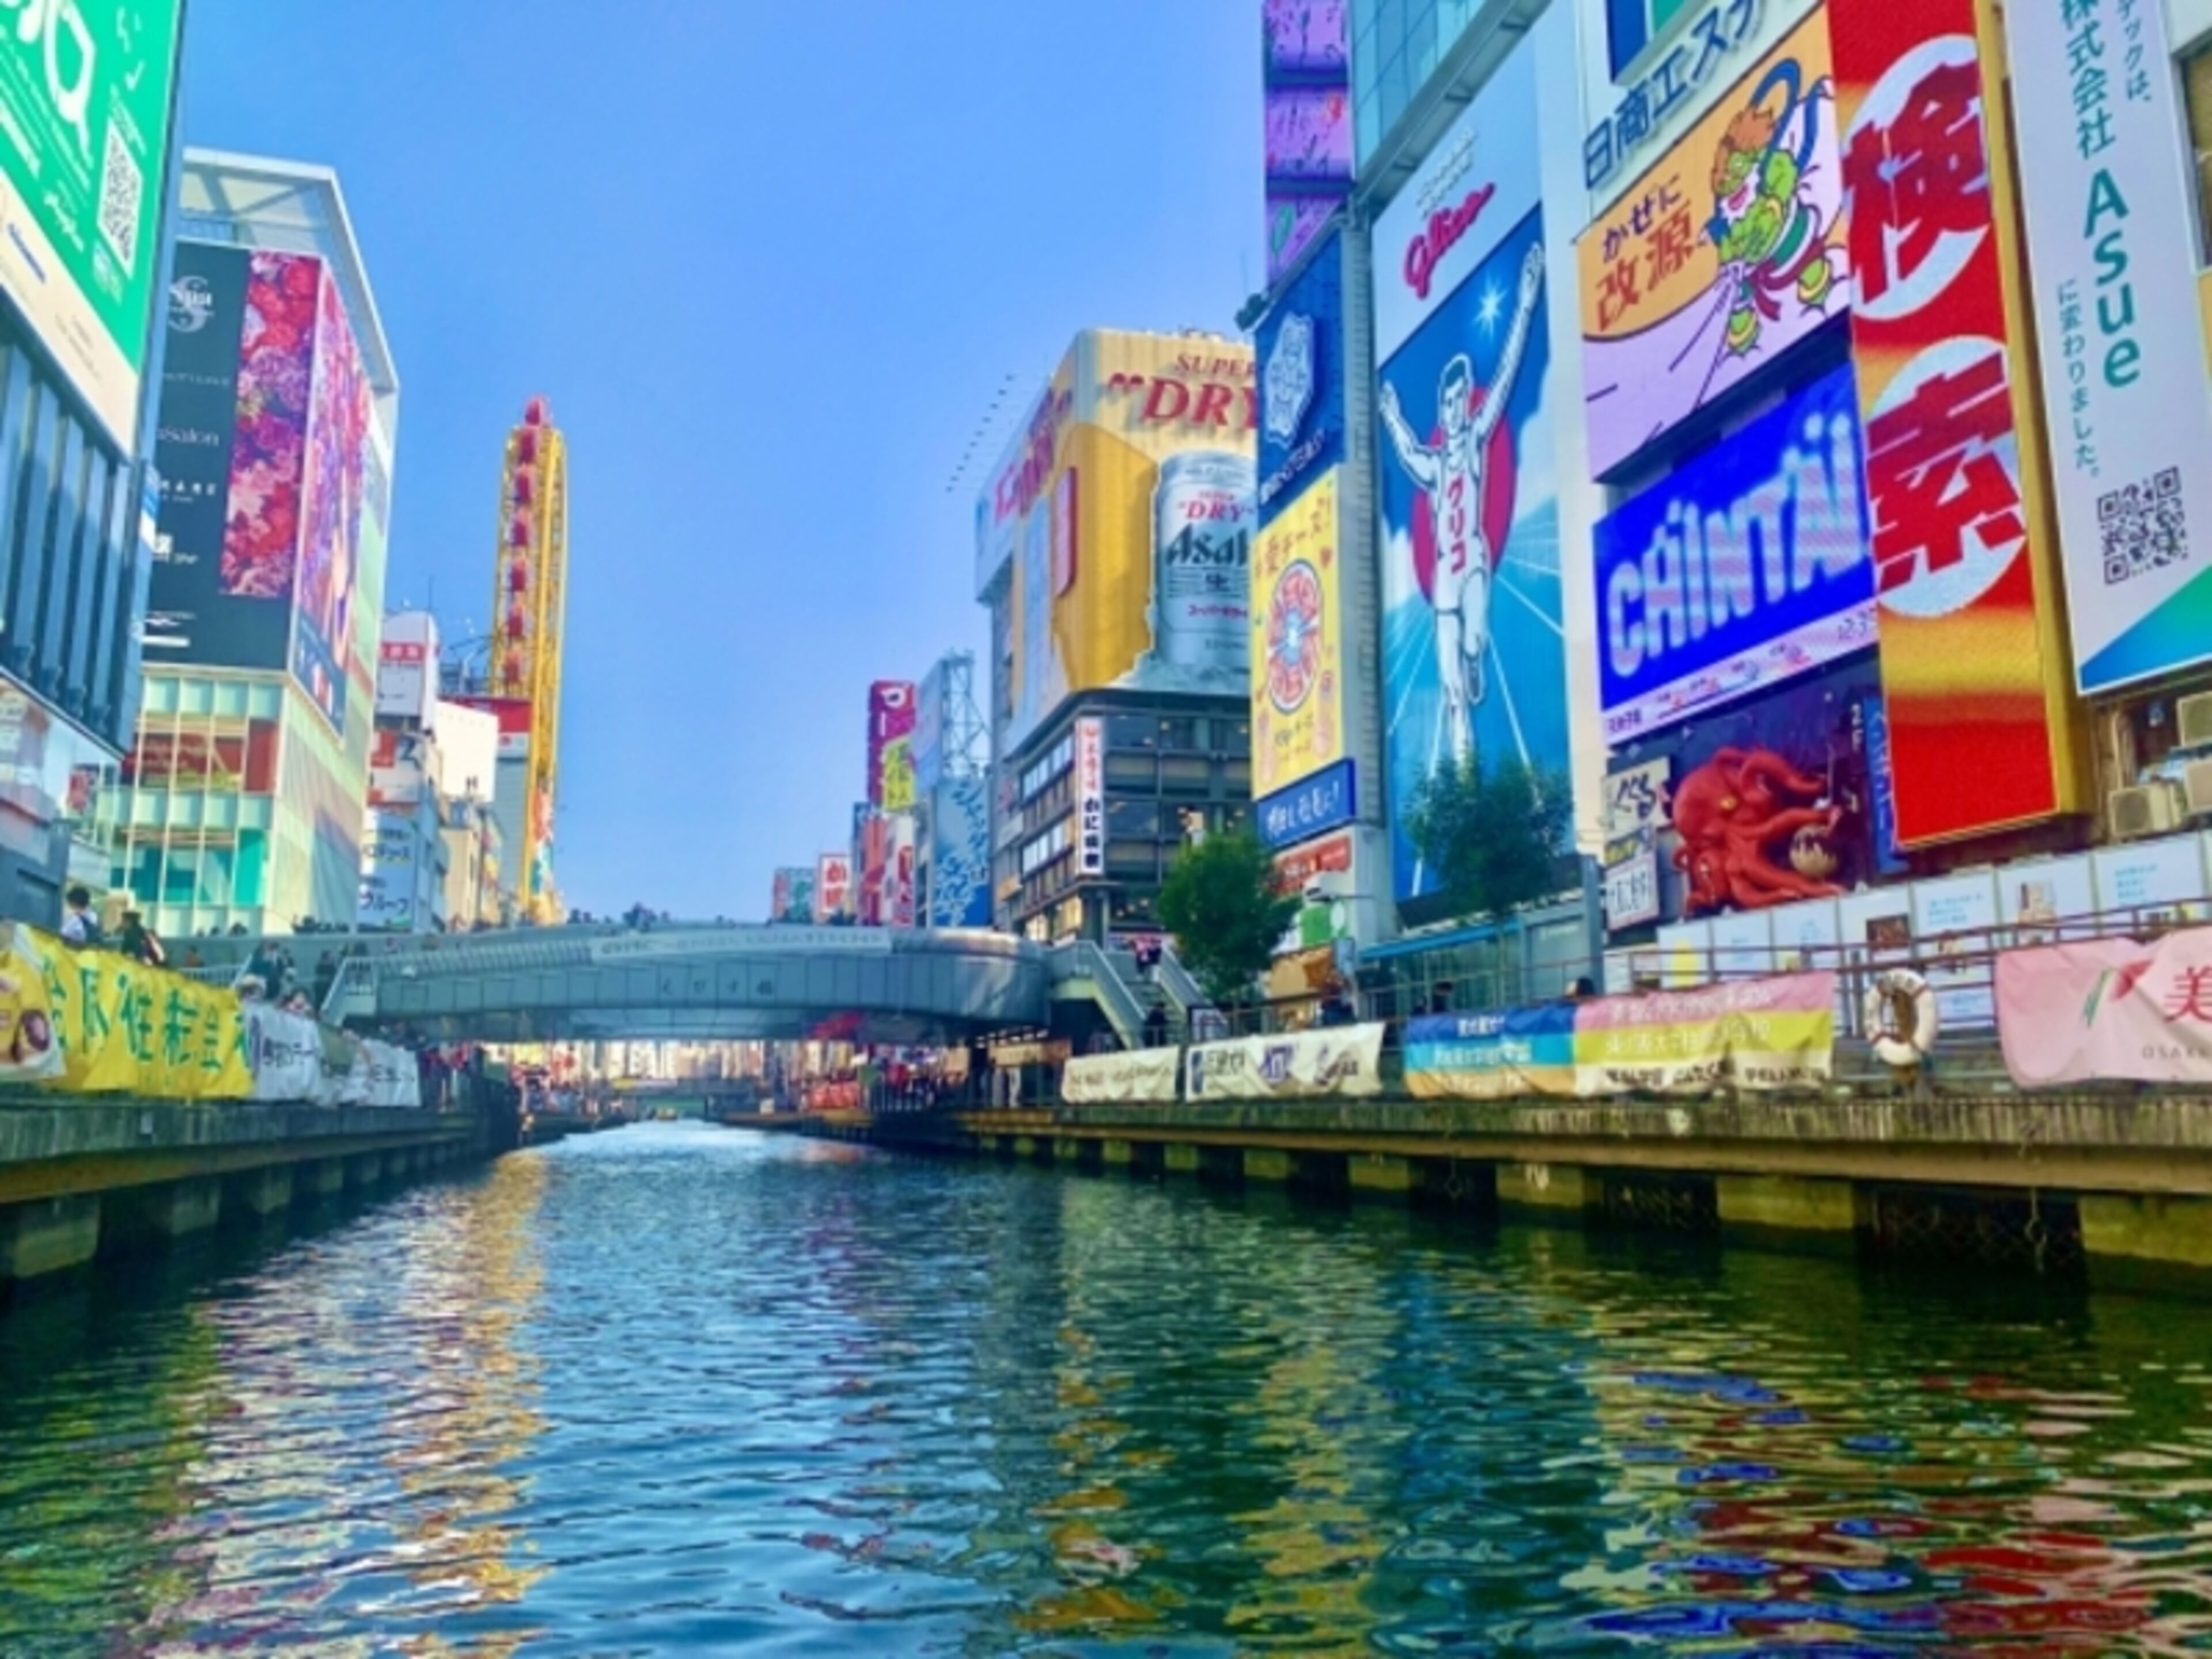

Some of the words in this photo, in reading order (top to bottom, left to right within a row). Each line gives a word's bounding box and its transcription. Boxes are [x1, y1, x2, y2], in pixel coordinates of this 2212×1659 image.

[1404, 181, 1496, 300] Glico
[1596, 199, 1696, 332] 改源
[1603, 174, 1681, 263] かぜに
[2084, 168, 2141, 388] Asue
[1842, 62, 2026, 594] 検索
[1166, 522, 1249, 567] Asa
[1447, 473, 1466, 575] グリコ
